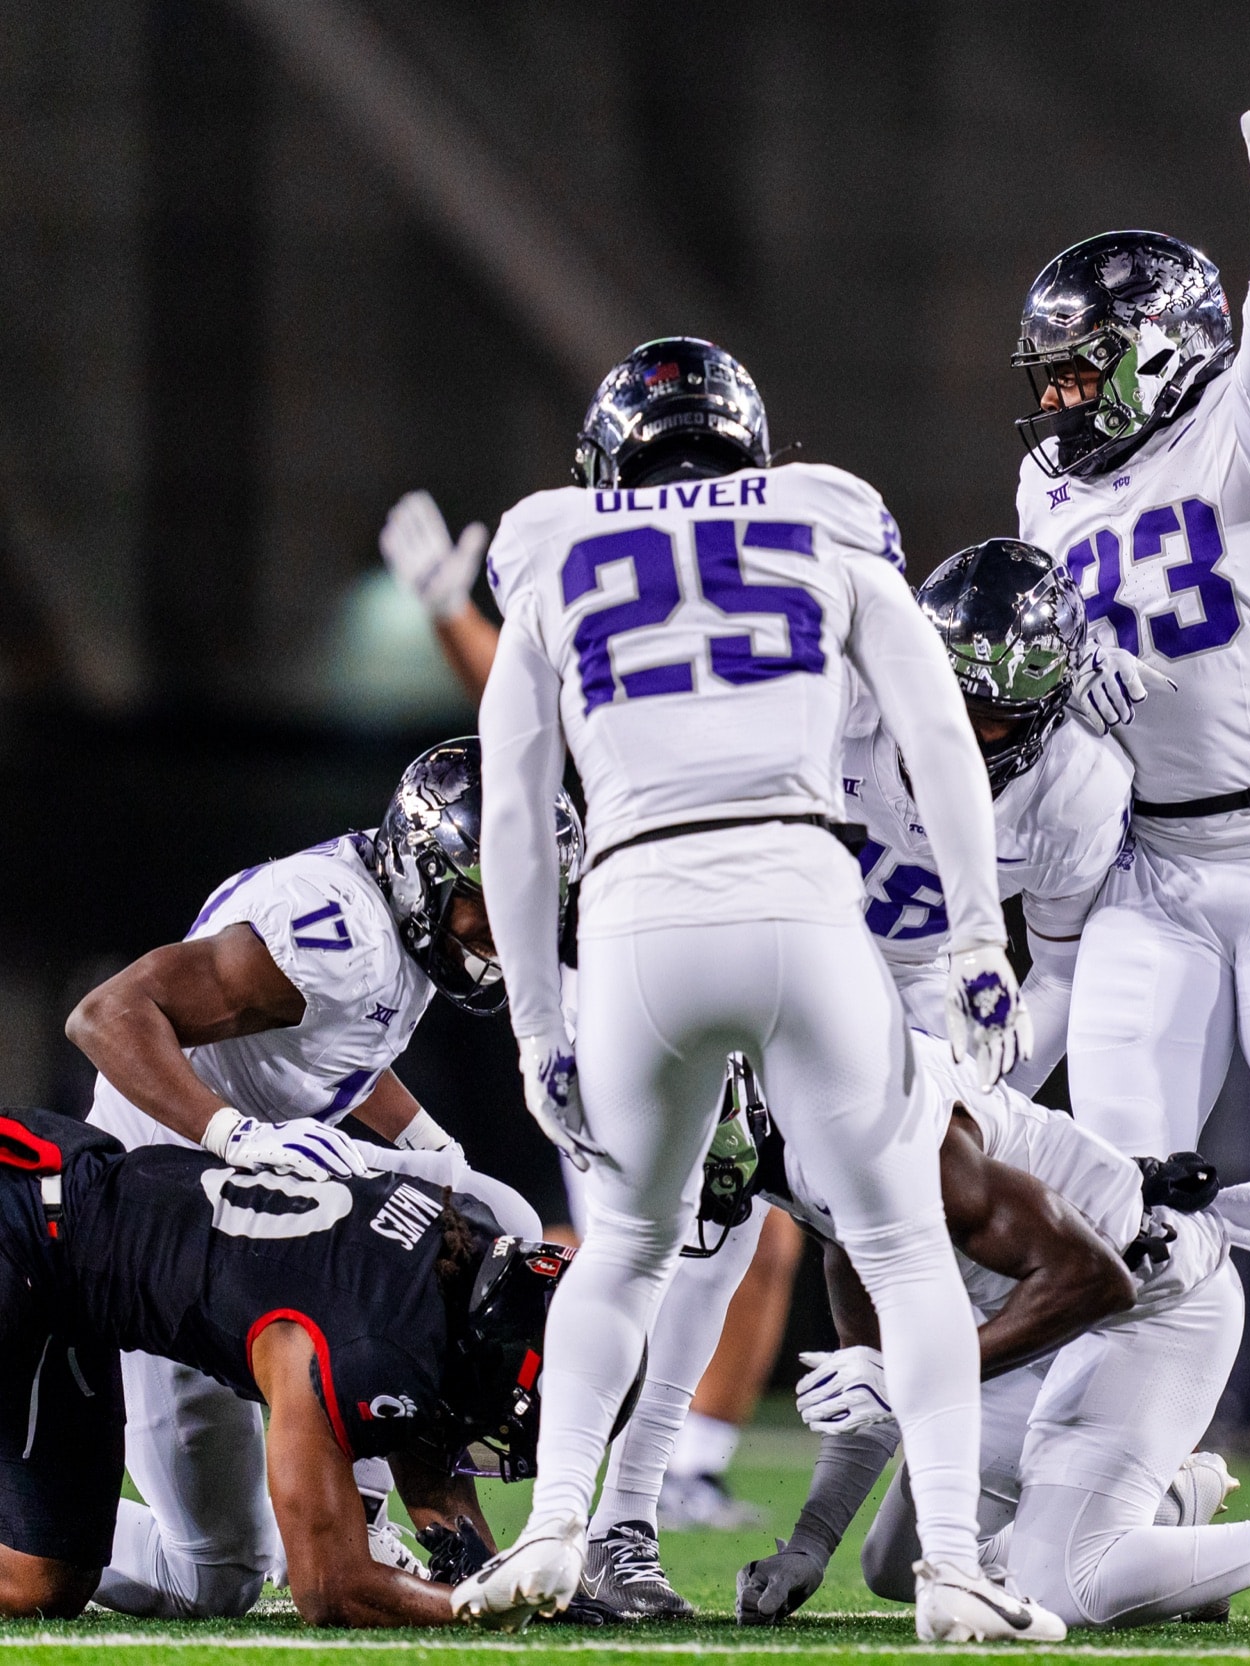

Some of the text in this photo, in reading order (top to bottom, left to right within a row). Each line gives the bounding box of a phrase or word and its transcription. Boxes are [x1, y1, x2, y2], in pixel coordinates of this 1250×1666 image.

[596, 477, 767, 513] OLIVER
[1047, 481, 1071, 510] XII
[1113, 476, 1131, 491] TCU
[1065, 493, 1244, 663] 33
[557, 518, 827, 721] 25
[291, 899, 354, 951] 17
[366, 1002, 399, 1027] XII
[200, 1167, 353, 1239] 0
[370, 1182, 444, 1250] MAYES
